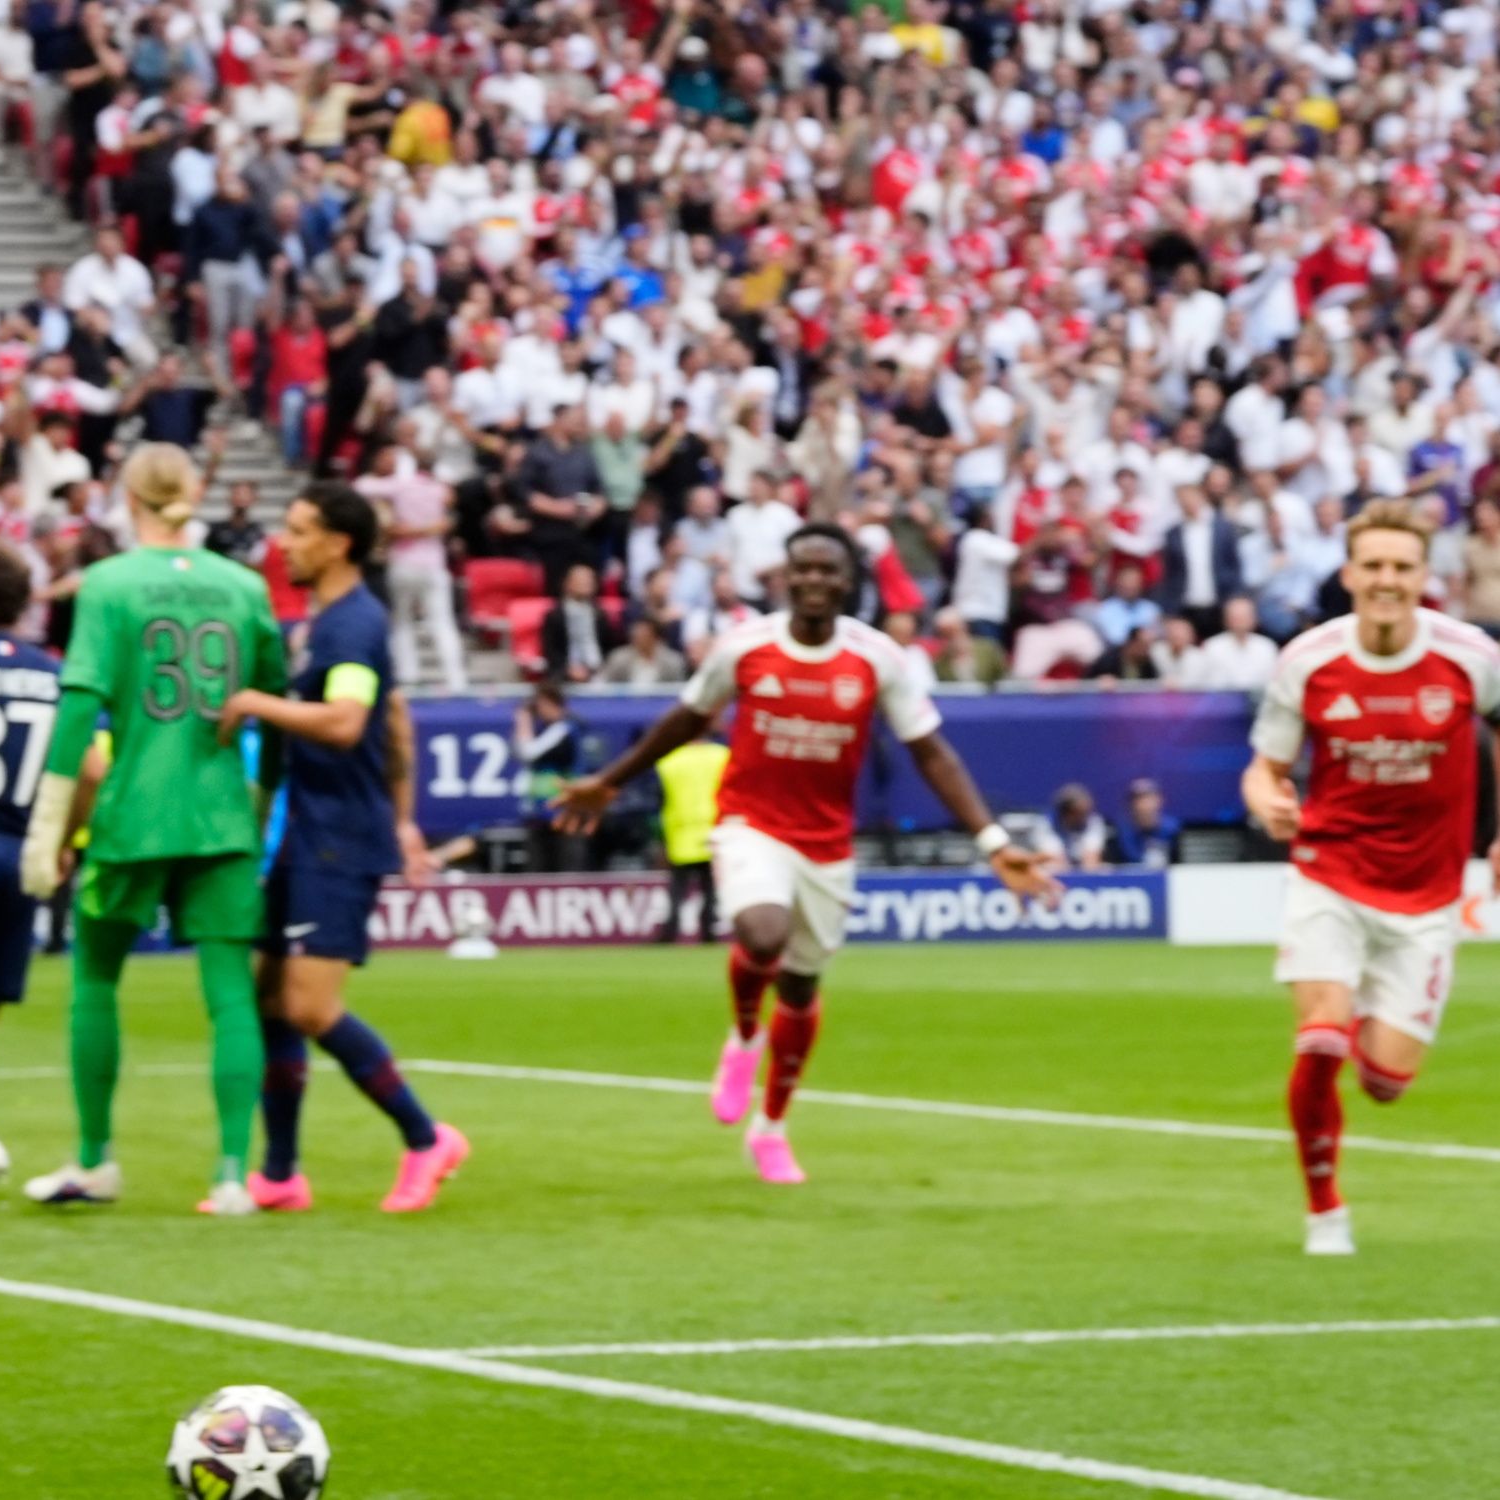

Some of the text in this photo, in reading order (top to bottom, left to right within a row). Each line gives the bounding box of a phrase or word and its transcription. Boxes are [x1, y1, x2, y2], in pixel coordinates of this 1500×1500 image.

[143, 616, 240, 722] 39
[428, 731, 531, 798] 12
[366, 888, 496, 941] TAR
